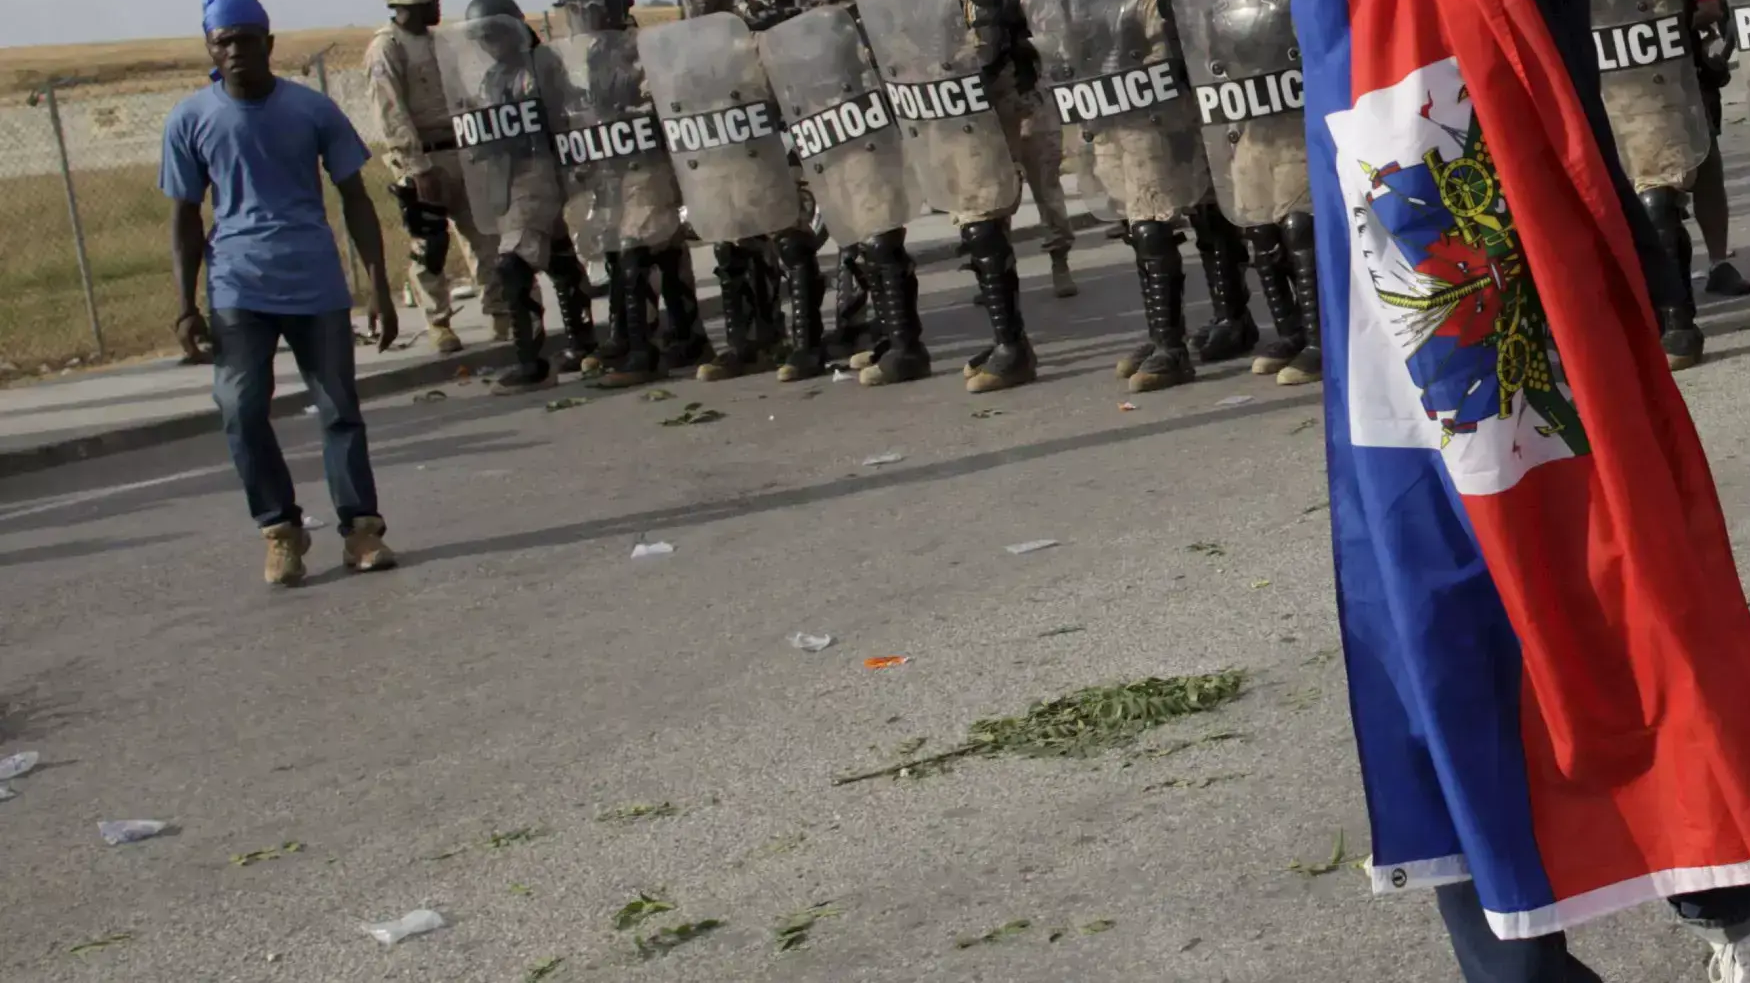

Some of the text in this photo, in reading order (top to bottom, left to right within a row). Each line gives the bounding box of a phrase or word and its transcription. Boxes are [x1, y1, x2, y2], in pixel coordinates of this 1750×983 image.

[1592, 17, 1685, 70] LICE
[886, 77, 989, 119] POLICE
[1055, 63, 1178, 123] POLICE
[1196, 70, 1304, 124] POLIC
[452, 100, 541, 148] POLICE
[555, 117, 656, 165] POLICE
[663, 103, 772, 153] POLICE
[792, 92, 889, 158] POLICE
